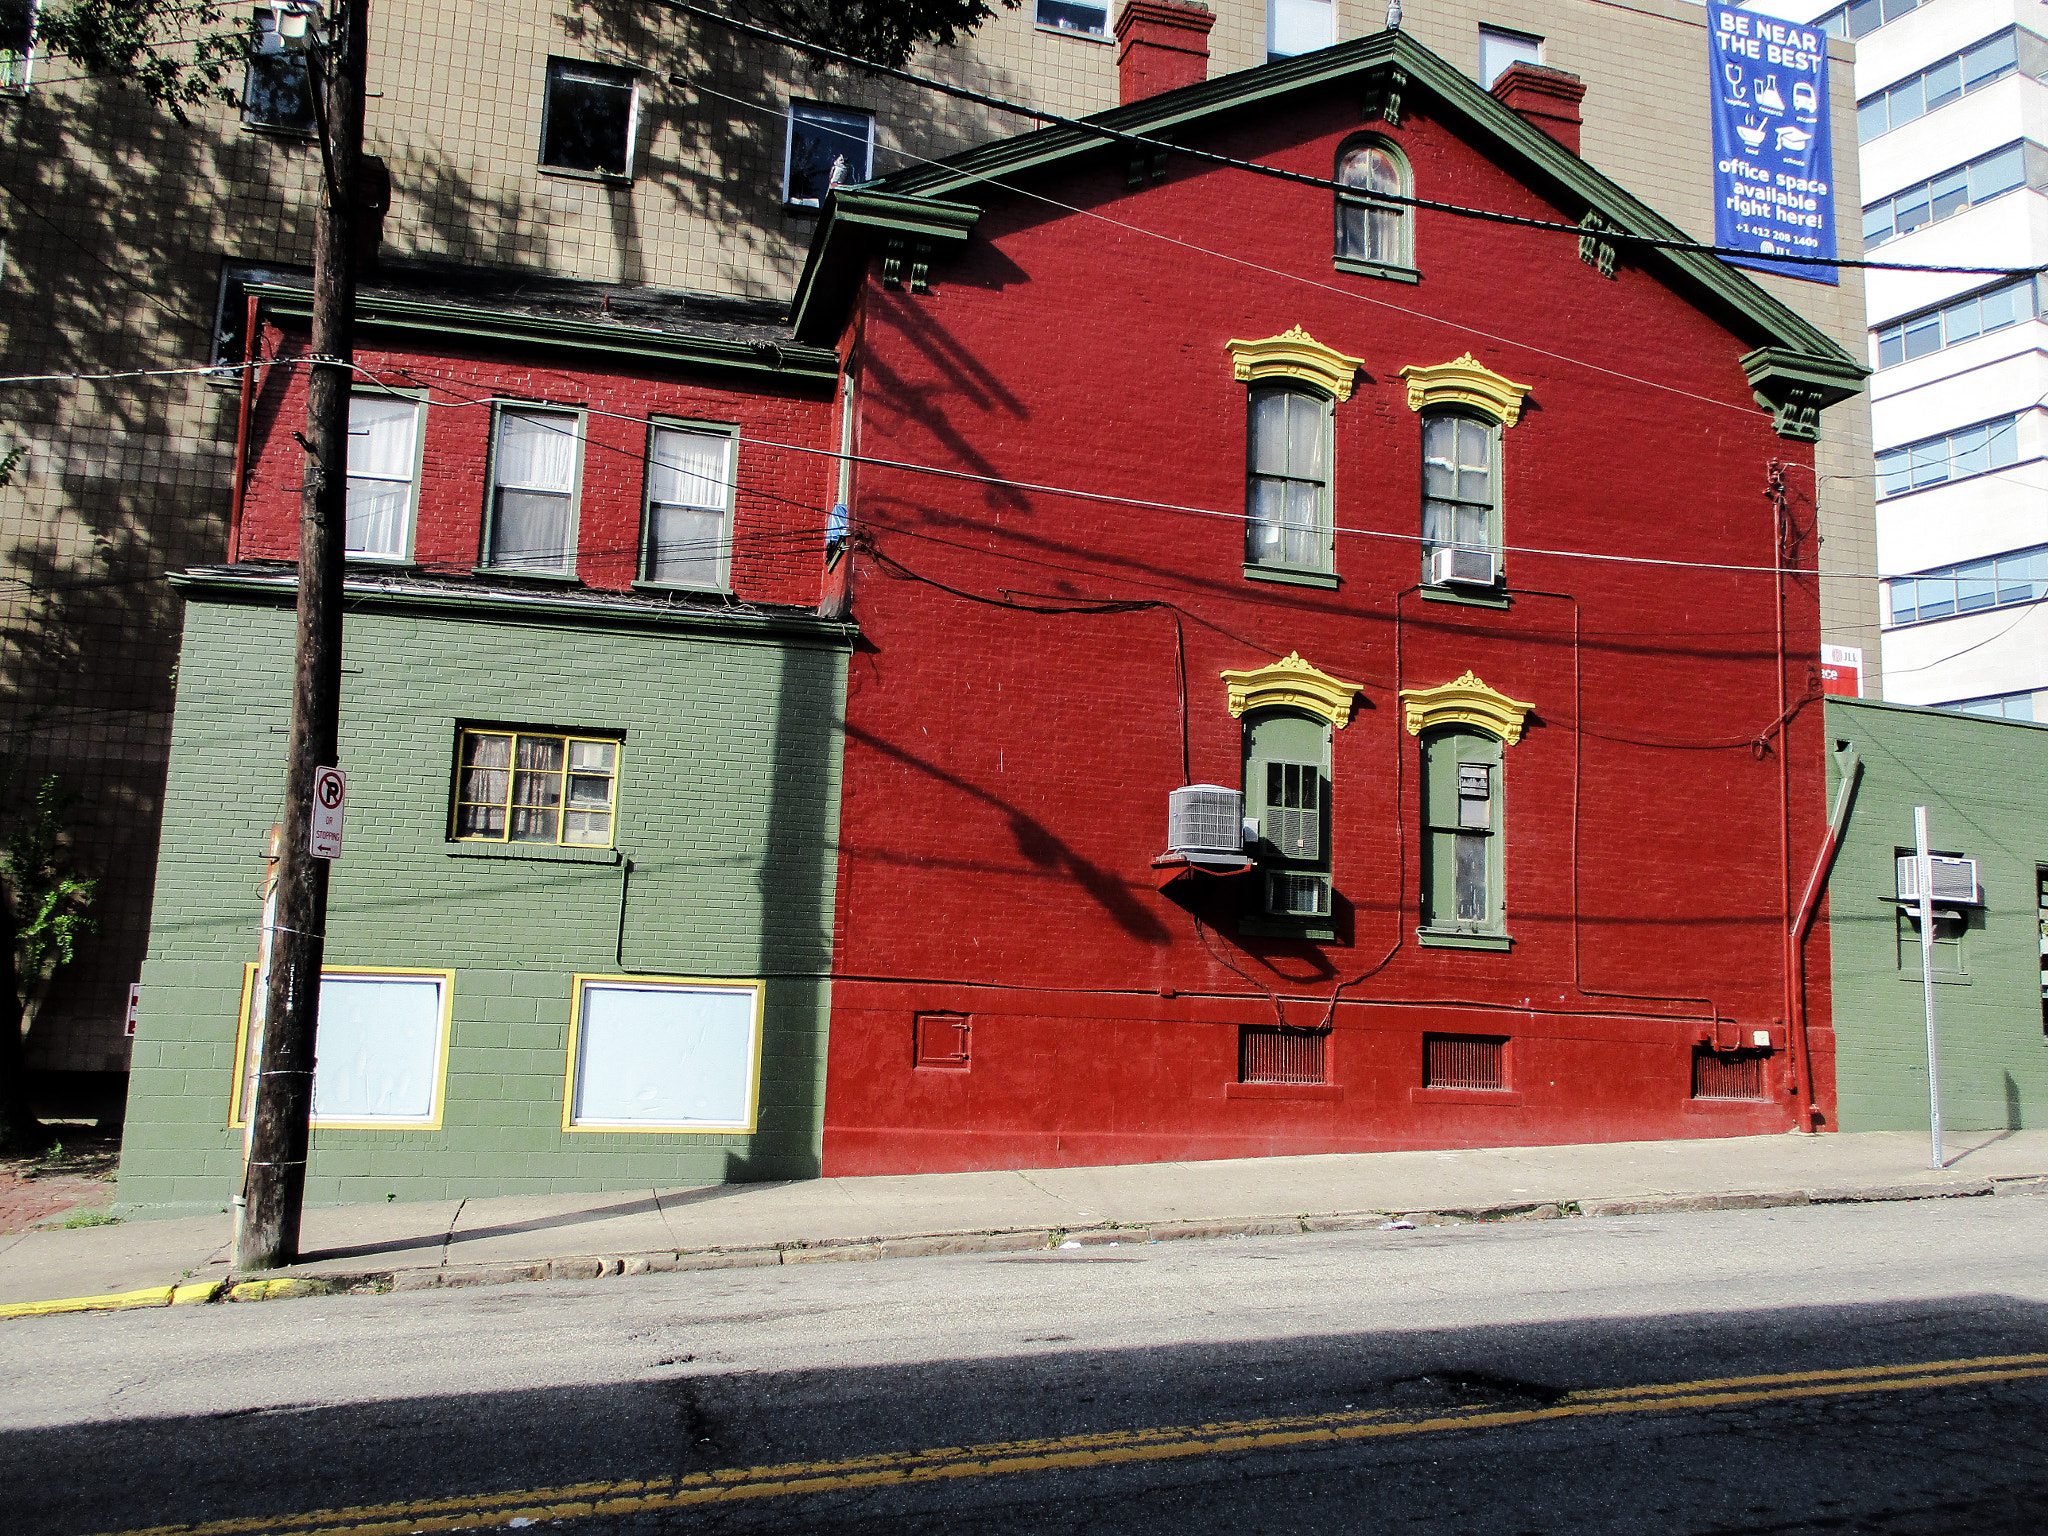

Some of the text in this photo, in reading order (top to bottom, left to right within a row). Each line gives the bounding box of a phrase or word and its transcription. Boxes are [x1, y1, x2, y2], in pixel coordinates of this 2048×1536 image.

[1720, 11, 1817, 52] BE NEAR
[1716, 31, 1822, 74] THE BEST
[1744, 147, 1759, 156] food
[1718, 158, 1828, 195] office space
[1733, 181, 1817, 211] available
[1726, 195, 1823, 229] right here!
[1735, 223, 1819, 248] +1 412 208 1400
[1843, 652, 1857, 662] JLL
[325, 816, 333, 825] OR
[316, 830, 339, 841] STOPPING
